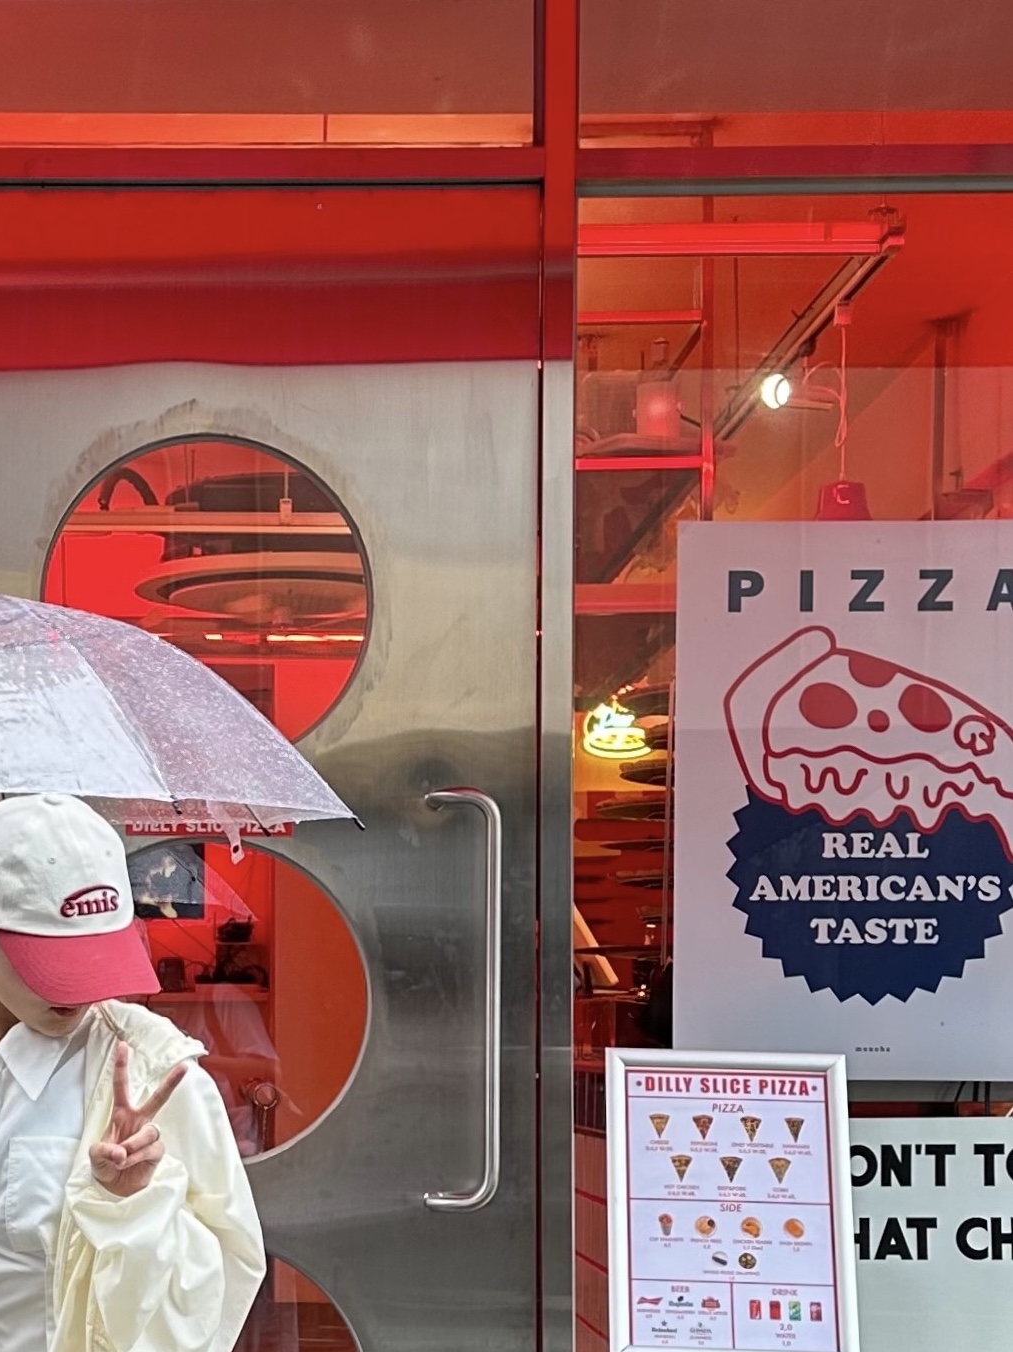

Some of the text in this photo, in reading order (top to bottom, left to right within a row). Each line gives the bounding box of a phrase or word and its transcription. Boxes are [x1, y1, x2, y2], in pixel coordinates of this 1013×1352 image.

[728, 569, 1013, 612] PIZZA
[822, 832, 929, 859] REAL
[749, 875, 1001, 901] AMERICAN'S
[60, 890, 119, 918] emis
[810, 918, 939, 944] TASTE
[644, 1076, 809, 1096] DILLY SLICE PIZZA
[712, 1103, 744, 1114] PIZZA
[850, 1143, 1013, 1187] ON'T T
[719, 1203, 742, 1213] SIDE
